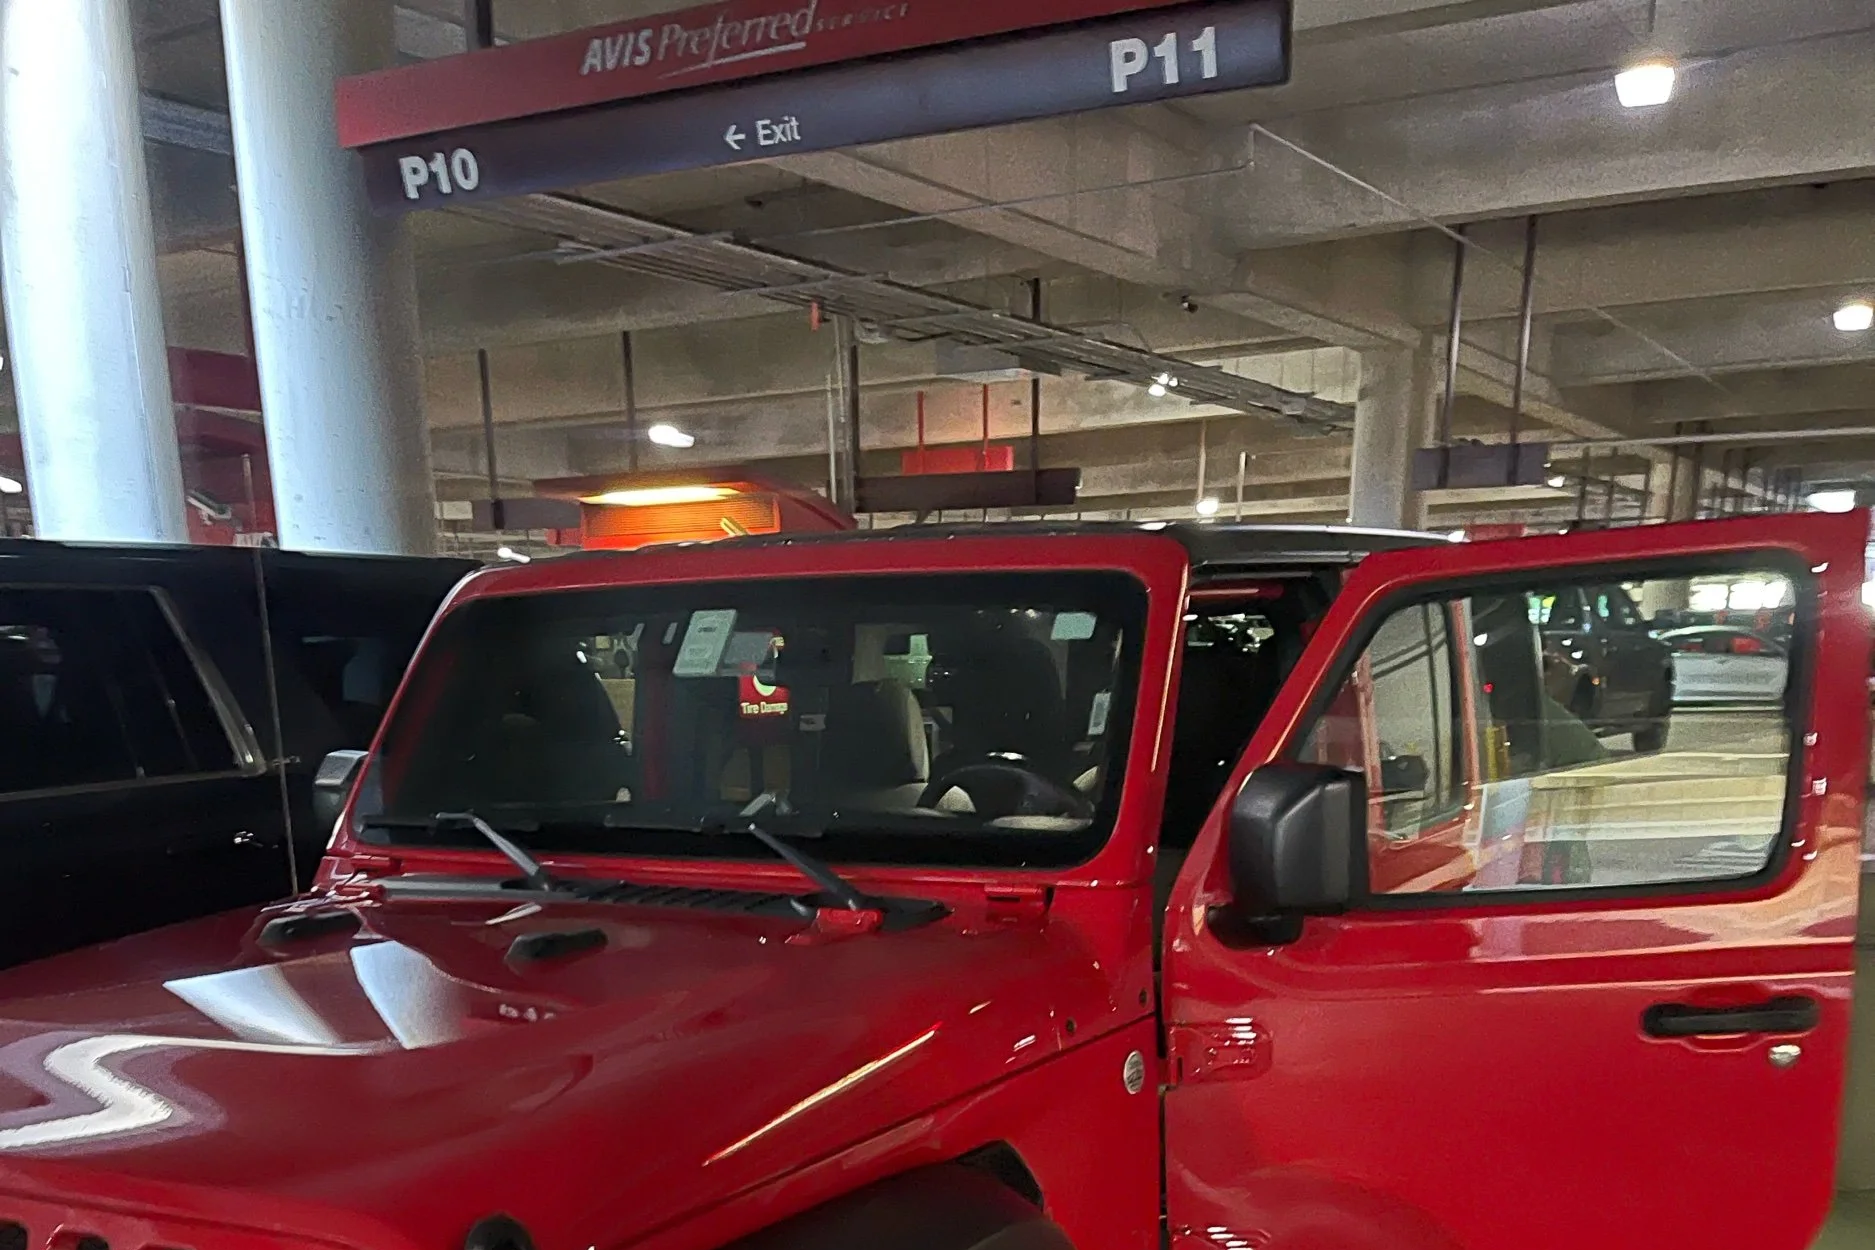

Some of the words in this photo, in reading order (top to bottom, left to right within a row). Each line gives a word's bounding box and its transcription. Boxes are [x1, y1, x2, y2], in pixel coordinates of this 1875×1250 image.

[579, 28, 653, 76] AVIS
[656, 0, 818, 68] Preferred
[1109, 26, 1218, 93] P11
[755, 115, 801, 146] Exit
[398, 147, 479, 199] P10
